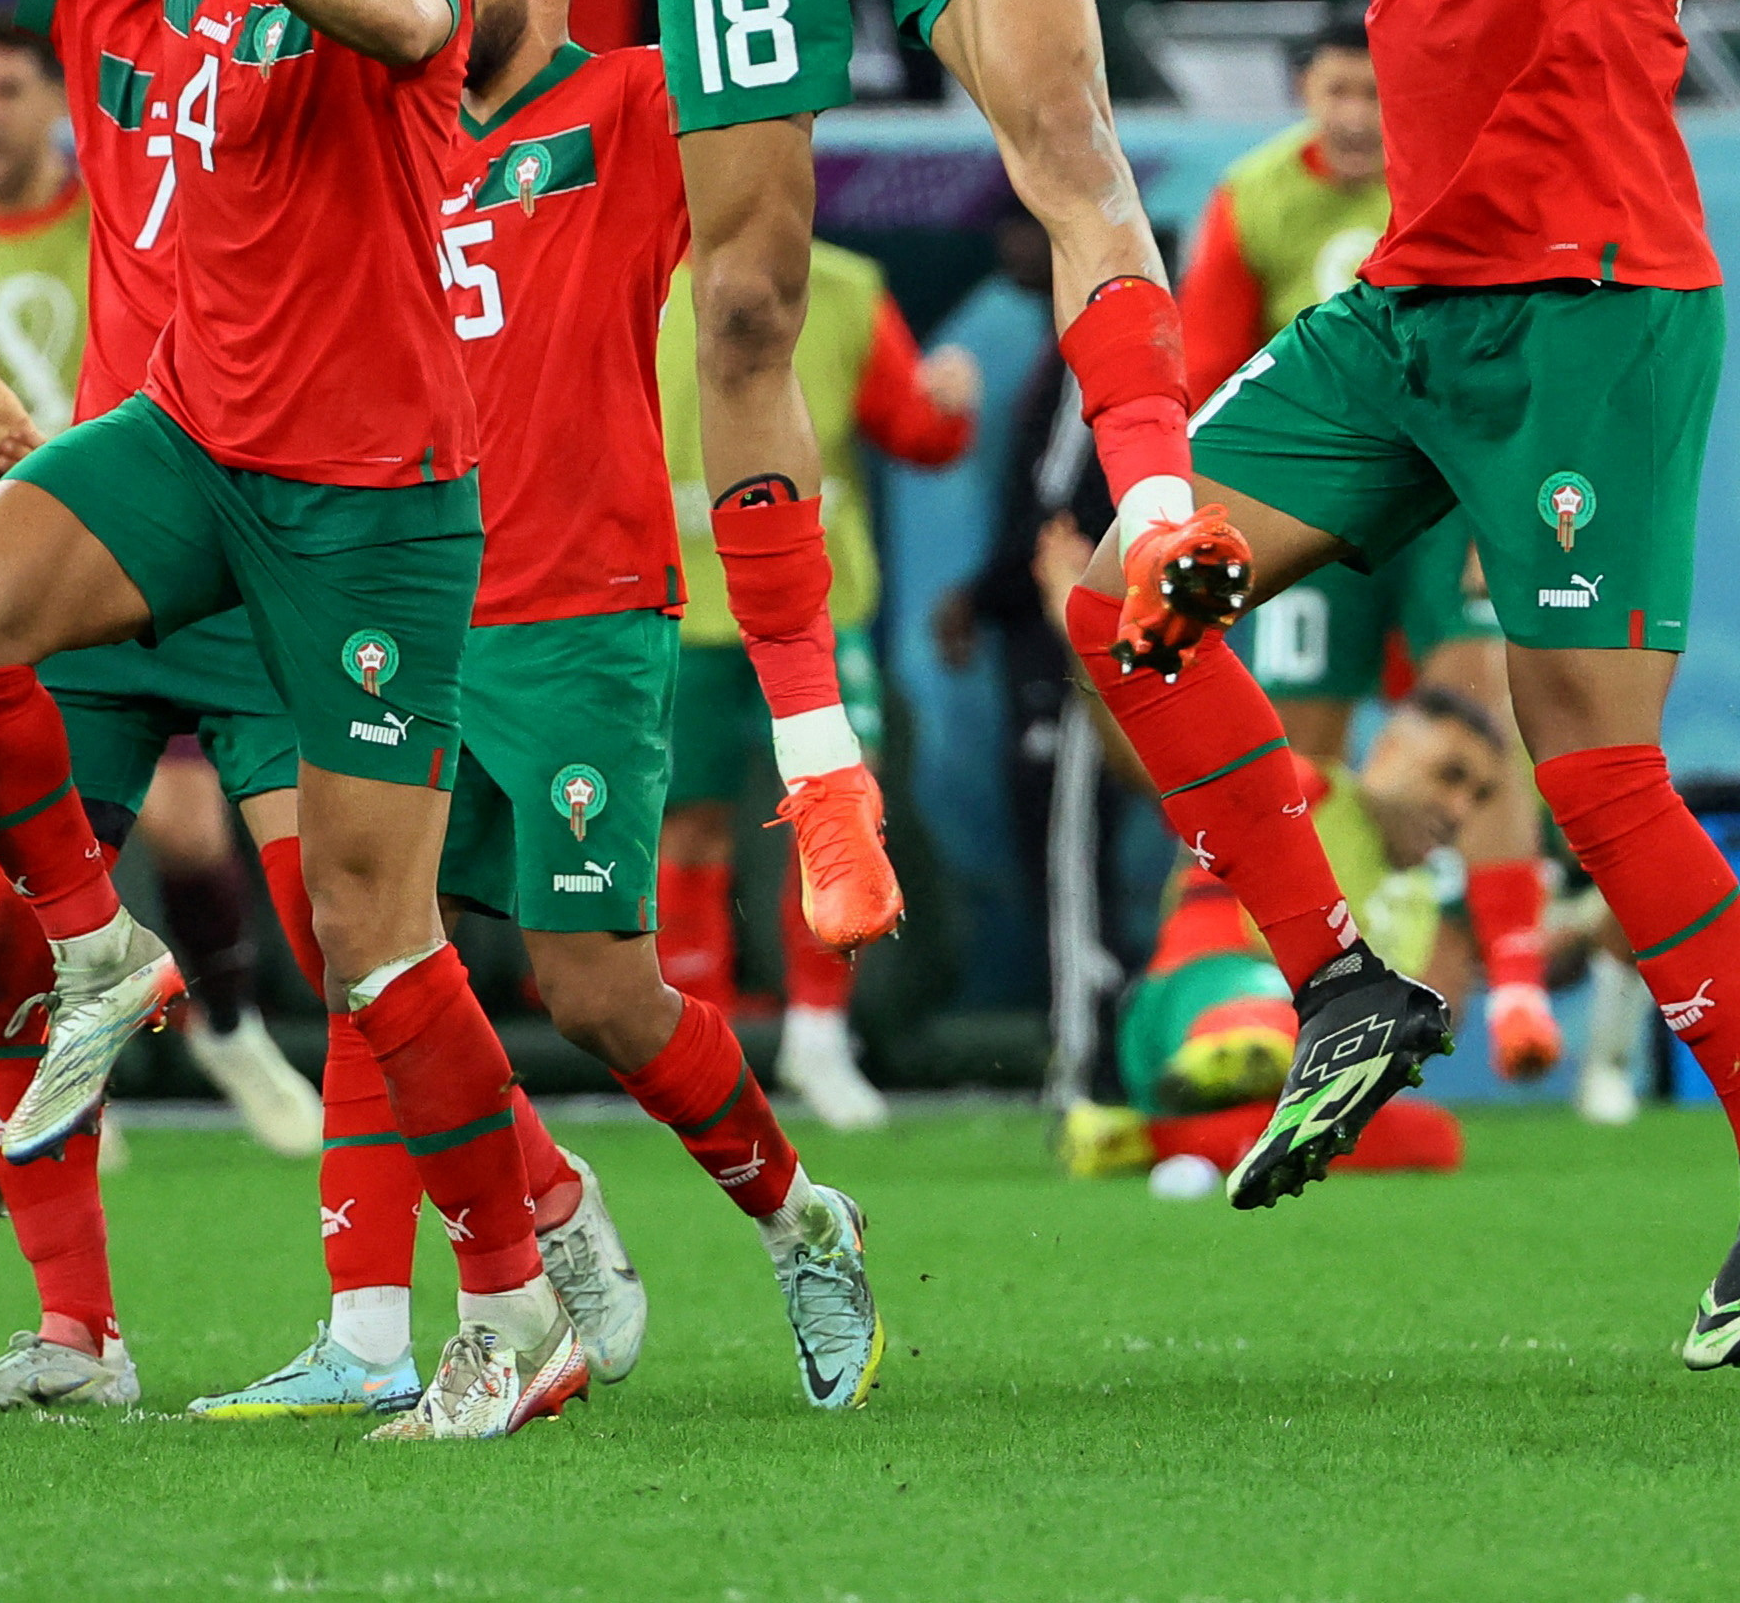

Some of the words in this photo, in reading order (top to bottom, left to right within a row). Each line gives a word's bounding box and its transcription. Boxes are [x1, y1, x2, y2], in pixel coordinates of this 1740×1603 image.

[176, 53, 218, 172] 4
[133, 135, 176, 249] 7
[1539, 589, 1590, 607] PUMA
[349, 721, 399, 746] PUMA
[553, 874, 603, 892] PUMA
